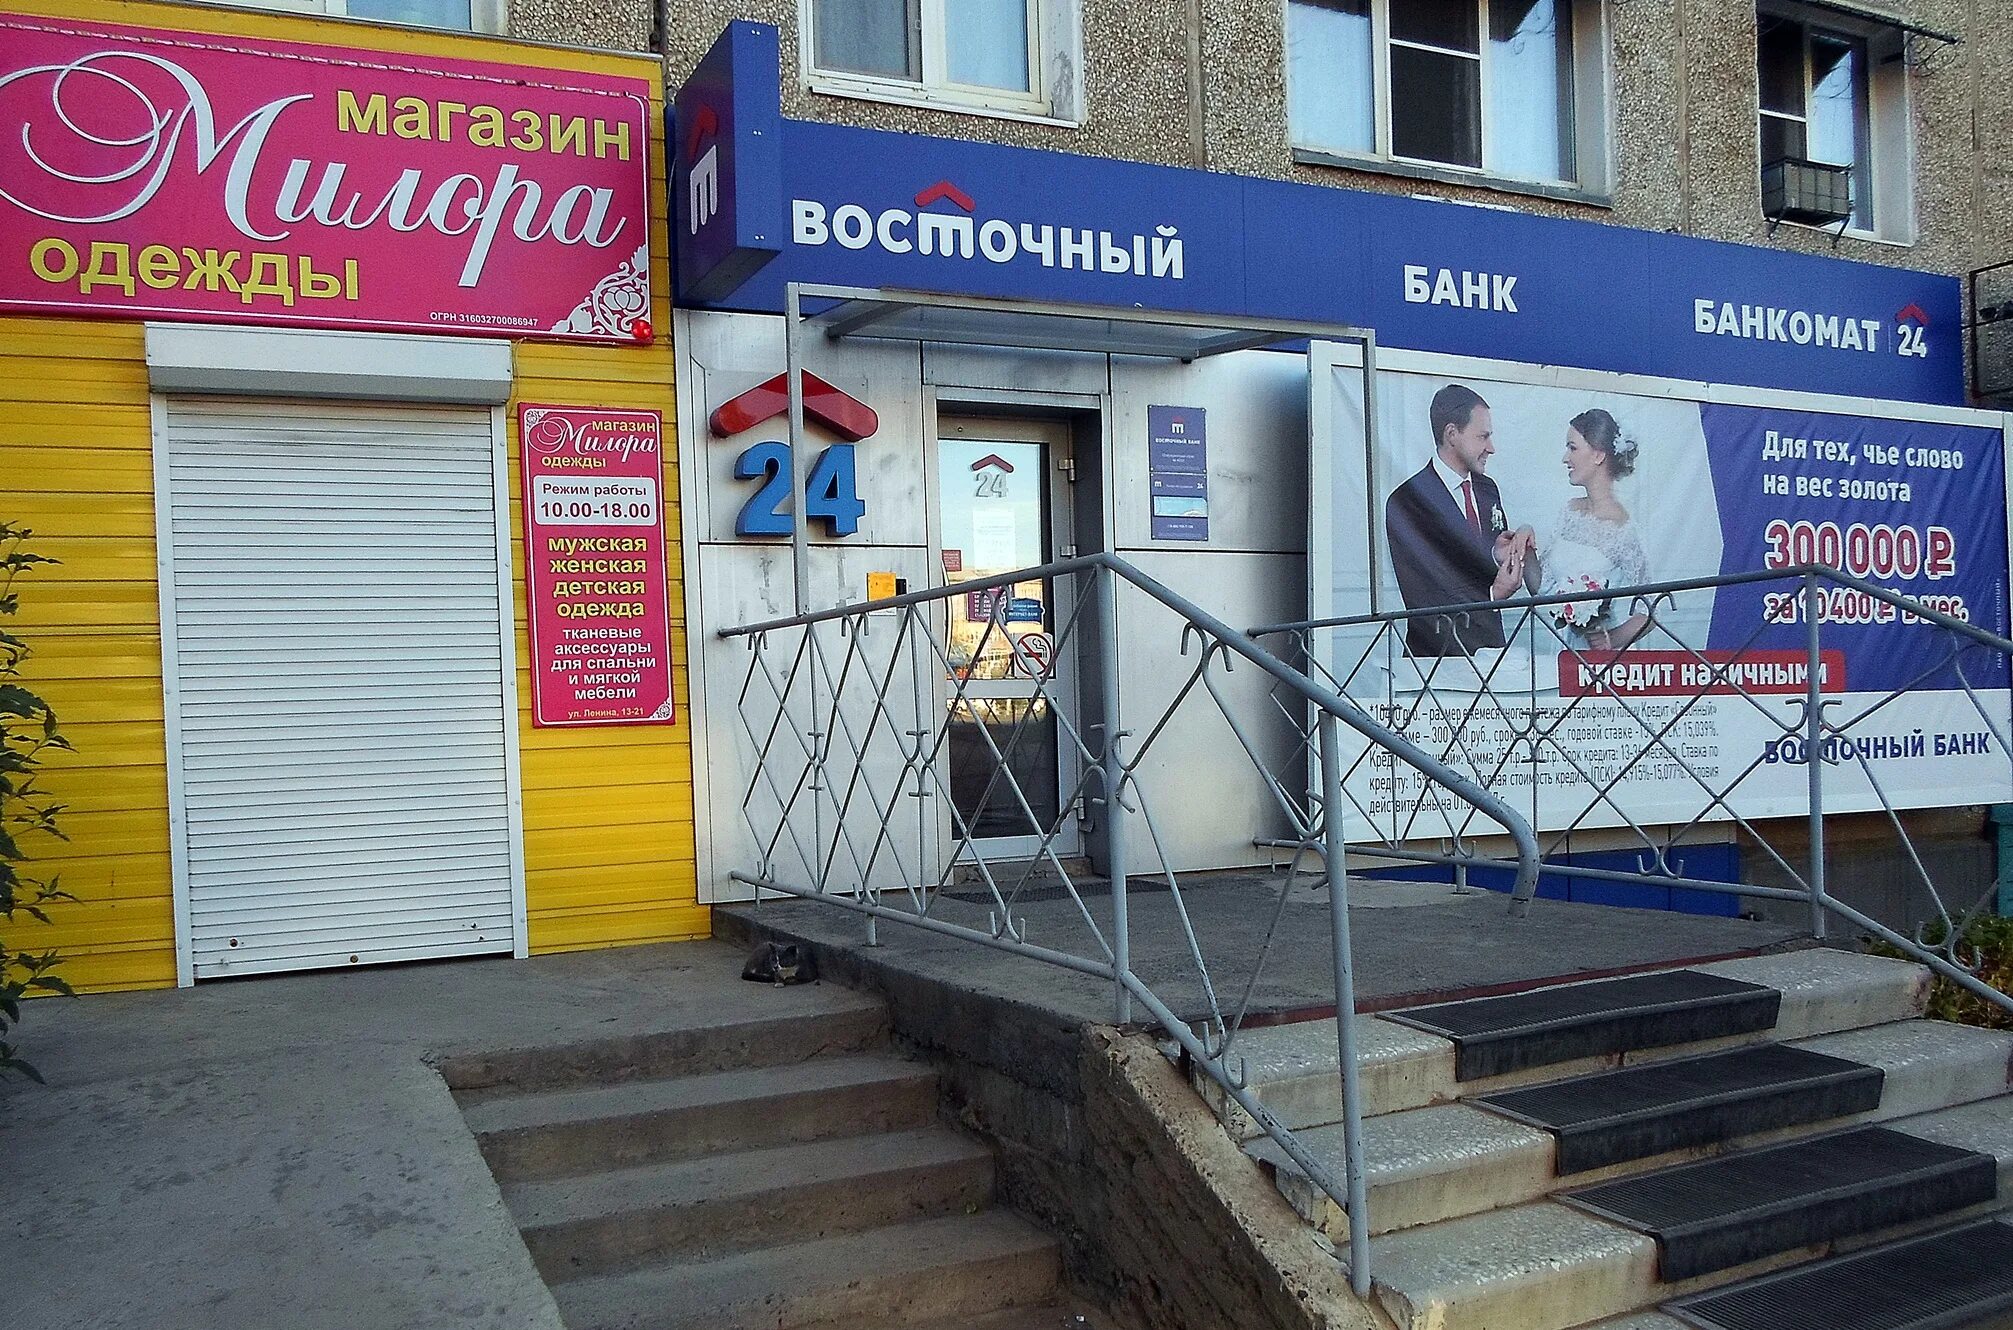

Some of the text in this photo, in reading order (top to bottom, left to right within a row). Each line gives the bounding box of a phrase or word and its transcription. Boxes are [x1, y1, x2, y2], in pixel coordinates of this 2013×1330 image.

[337, 89, 631, 161] магазин
[0, 51, 627, 287] Милора
[29, 237, 360, 307] одежды
[1403, 263, 1520, 314] БАНК
[430, 311, 457, 322] ОГРН
[1694, 298, 1928, 358] БАНКОМАТ 24
[592, 420, 656, 432] магазин
[528, 416, 657, 463] Милора
[1762, 430, 1964, 470] Для тех, чье слово
[541, 455, 607, 469] одежды
[542, 483, 647, 497] Режим работы
[734, 440, 866, 537] 24
[974, 471, 1008, 498] 24
[1763, 473, 1911, 501] на вес золота
[540, 501, 651, 518] 10.00-18.00
[547, 537, 648, 556] мужская
[550, 559, 647, 574] женская
[553, 580, 646, 598] детская
[556, 602, 645, 620] одежда
[1763, 592, 1797, 624] за
[562, 627, 642, 640] тканевые
[554, 642, 652, 657] аксессуары
[551, 656, 656, 672] для спальни
[568, 670, 641, 685] и мягкой
[1578, 662, 1828, 694] кредит наличными
[574, 687, 637, 700] мебели
[568, 710, 581, 720] ул.
[621, 707, 644, 717] 13-21
[1429, 708, 1461, 725] размер
[1463, 707, 1523, 720] ежемесяного
[1526, 706, 1559, 719] патежа
[1573, 703, 1616, 722] тарифному
[1641, 701, 1669, 721] Кредит
[1671, 701, 1717, 716] «Сеонный»
[1567, 724, 1601, 743] годовой
[1604, 727, 1633, 739] ставке
[1584, 748, 1619, 764] кредита:
[1681, 742, 1707, 758] Ставка
[1709, 745, 1718, 757] по
[1934, 731, 1990, 757] БАНК
[1369, 777, 1409, 794] кредту:
